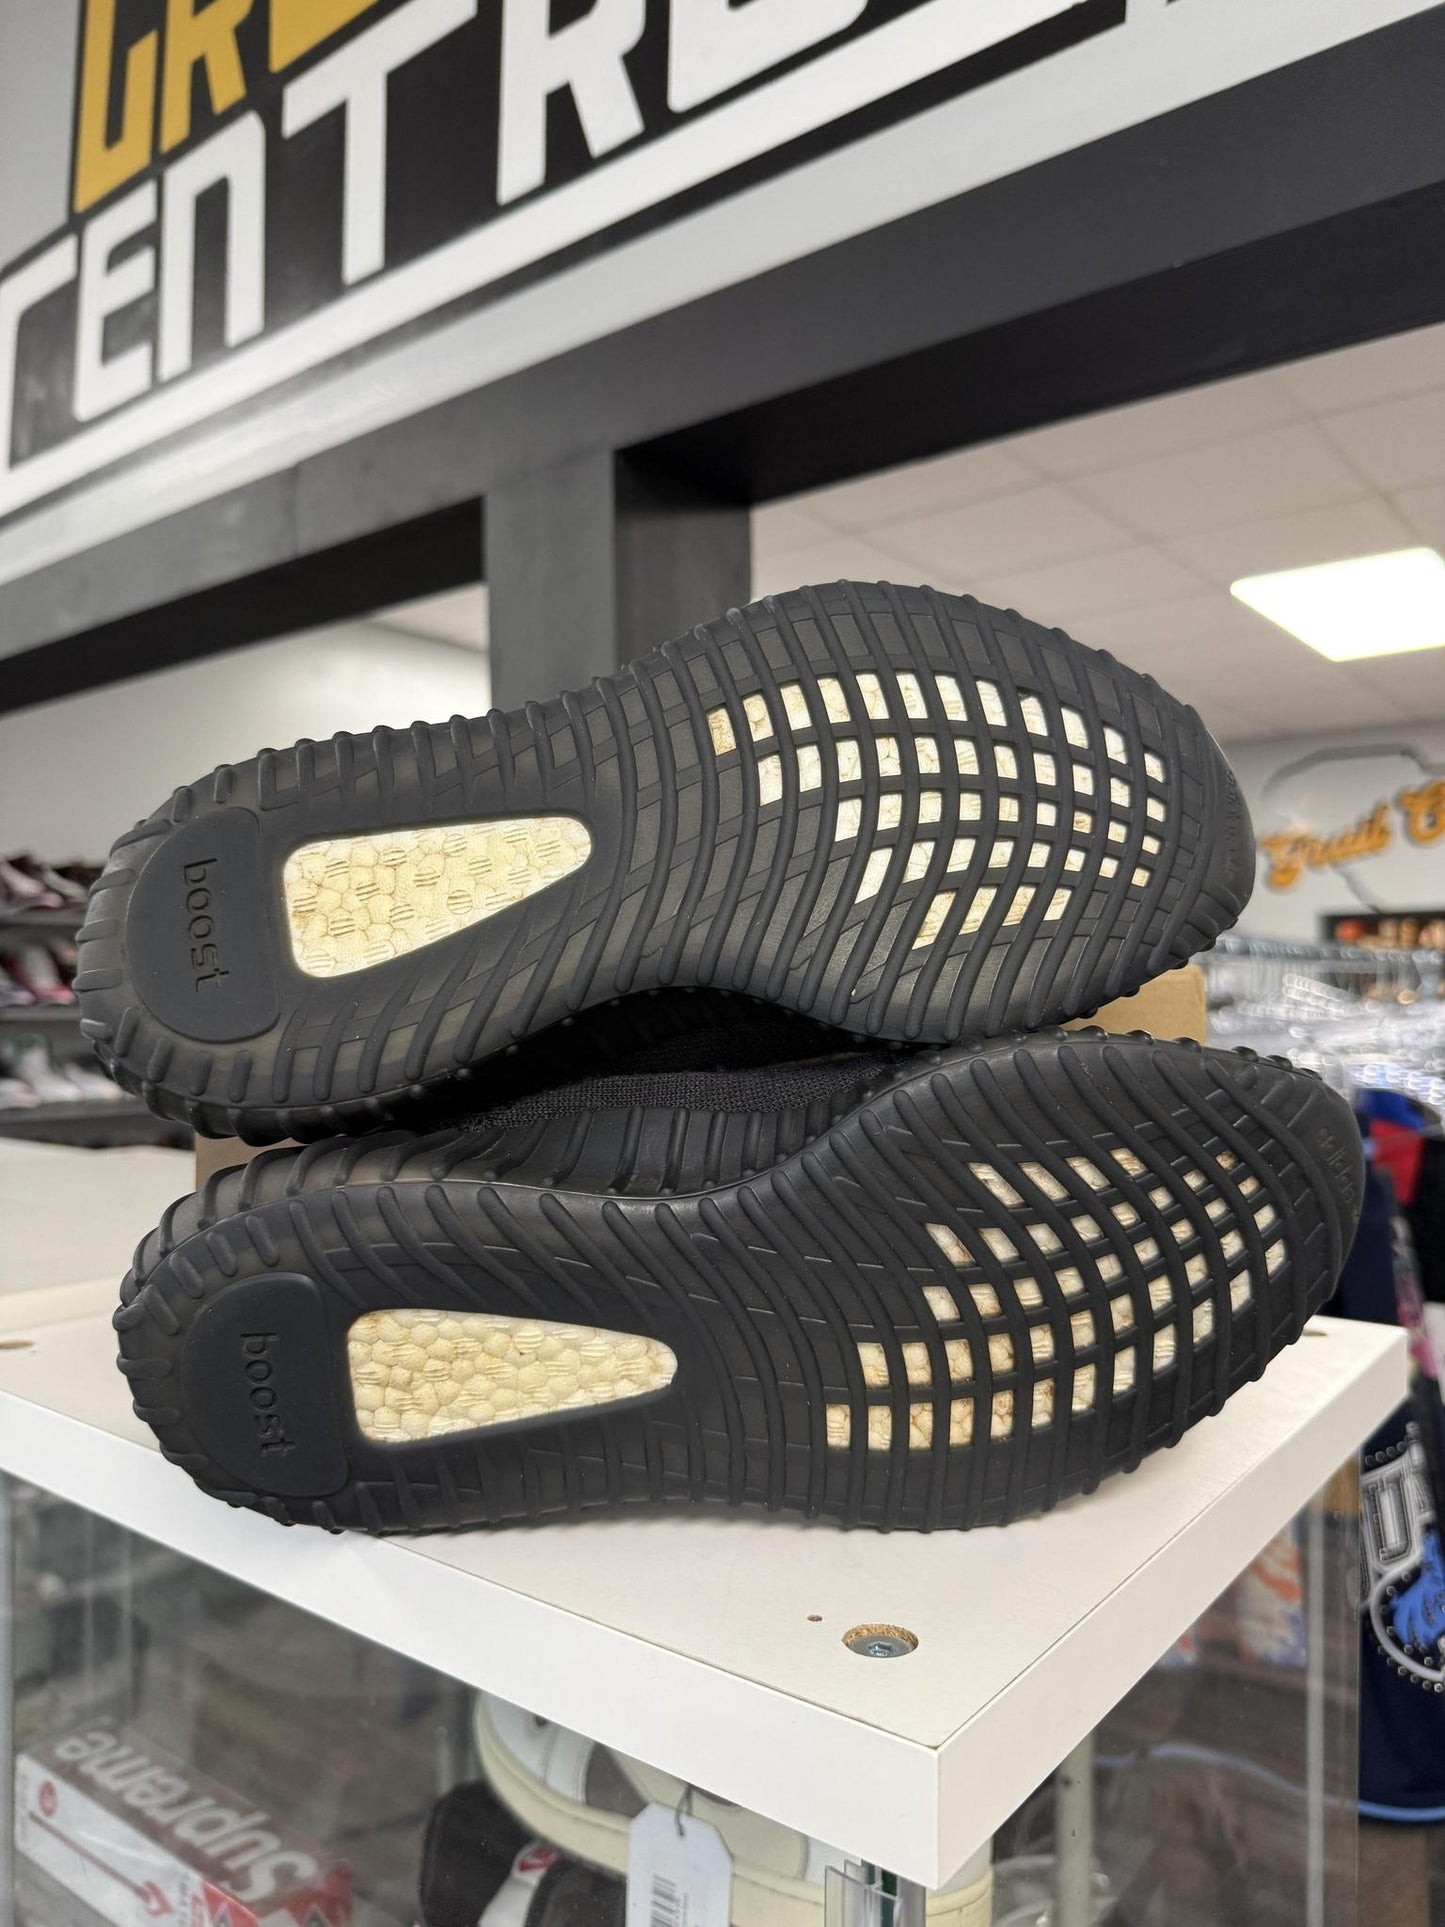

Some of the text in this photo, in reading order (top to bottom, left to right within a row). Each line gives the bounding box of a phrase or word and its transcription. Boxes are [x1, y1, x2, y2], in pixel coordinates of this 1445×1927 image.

[184, 857, 230, 993] boost
[240, 1331, 298, 1458] boost
[54, 1730, 320, 1901] Supreme
